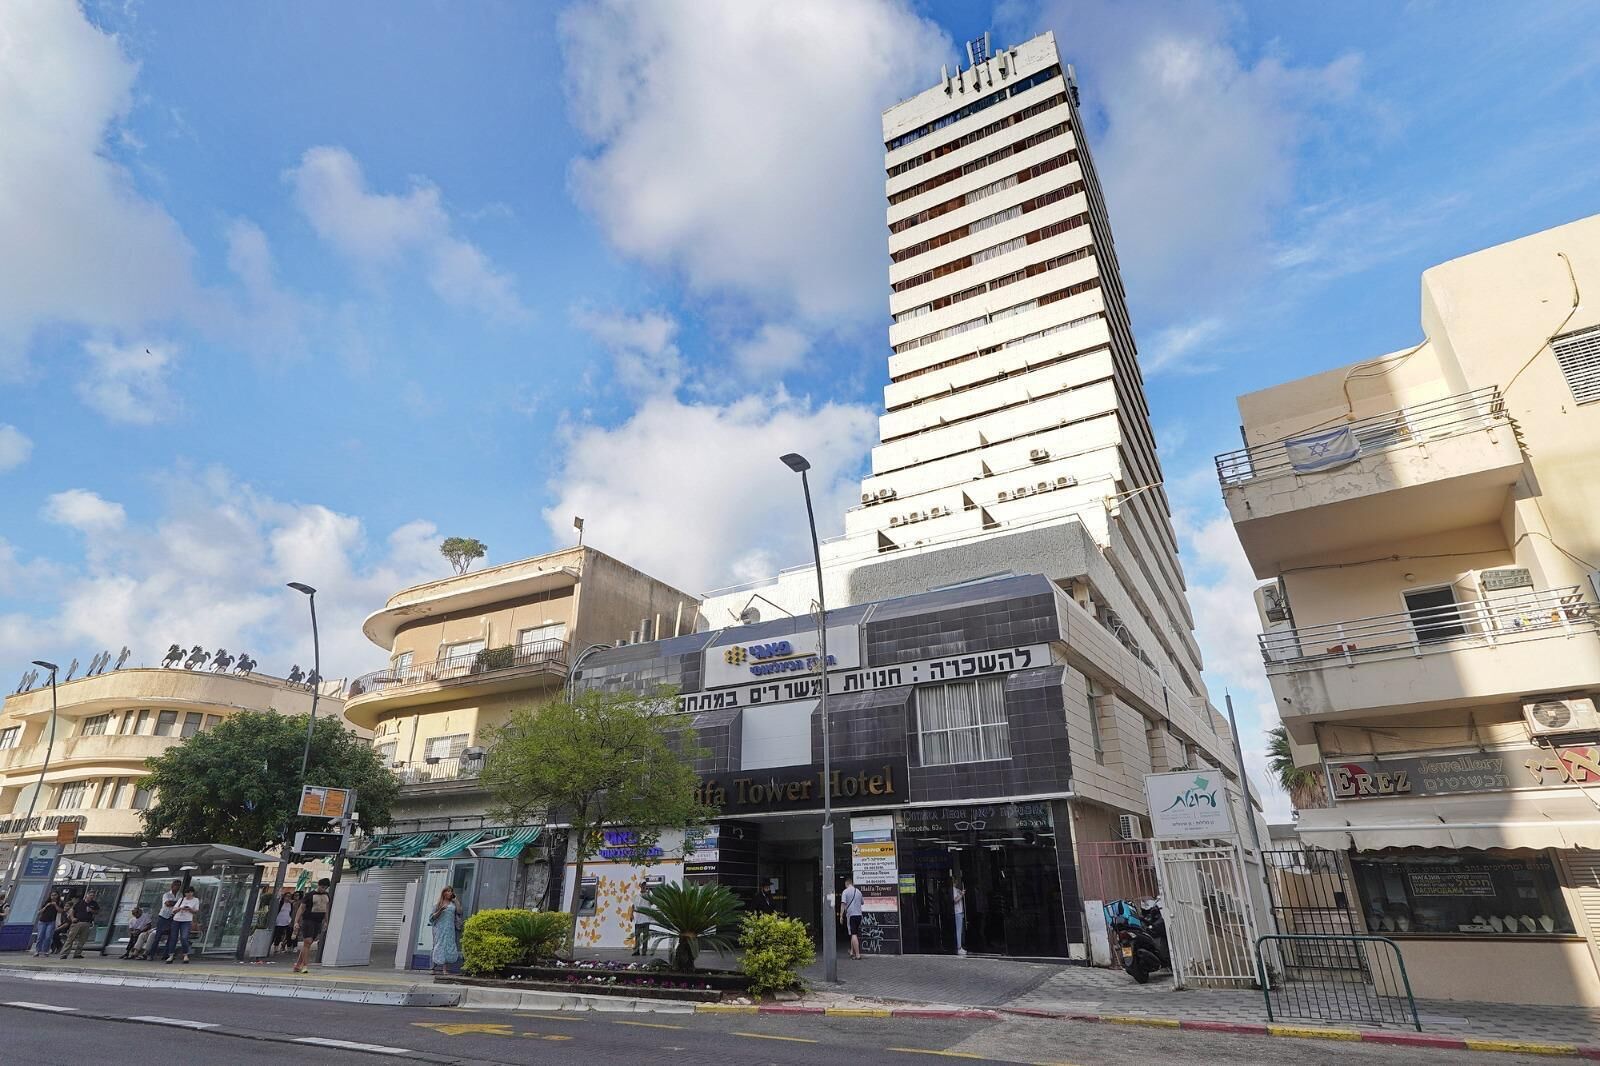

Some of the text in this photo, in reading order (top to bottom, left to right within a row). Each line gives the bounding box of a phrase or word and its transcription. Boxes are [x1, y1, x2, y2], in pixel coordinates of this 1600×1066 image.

[930, 648, 1032, 680] להשכרה
[750, 677, 830, 704] ומשרדים
[844, 668, 902, 691] חנויות
[1418, 756, 1504, 775] Jewellery
[1524, 747, 1600, 784] ארז
[733, 777, 814, 805] Tower
[817, 765, 895, 799] Hotel
[1332, 764, 1411, 797] EREZ
[1423, 774, 1511, 791] תכשיטים
